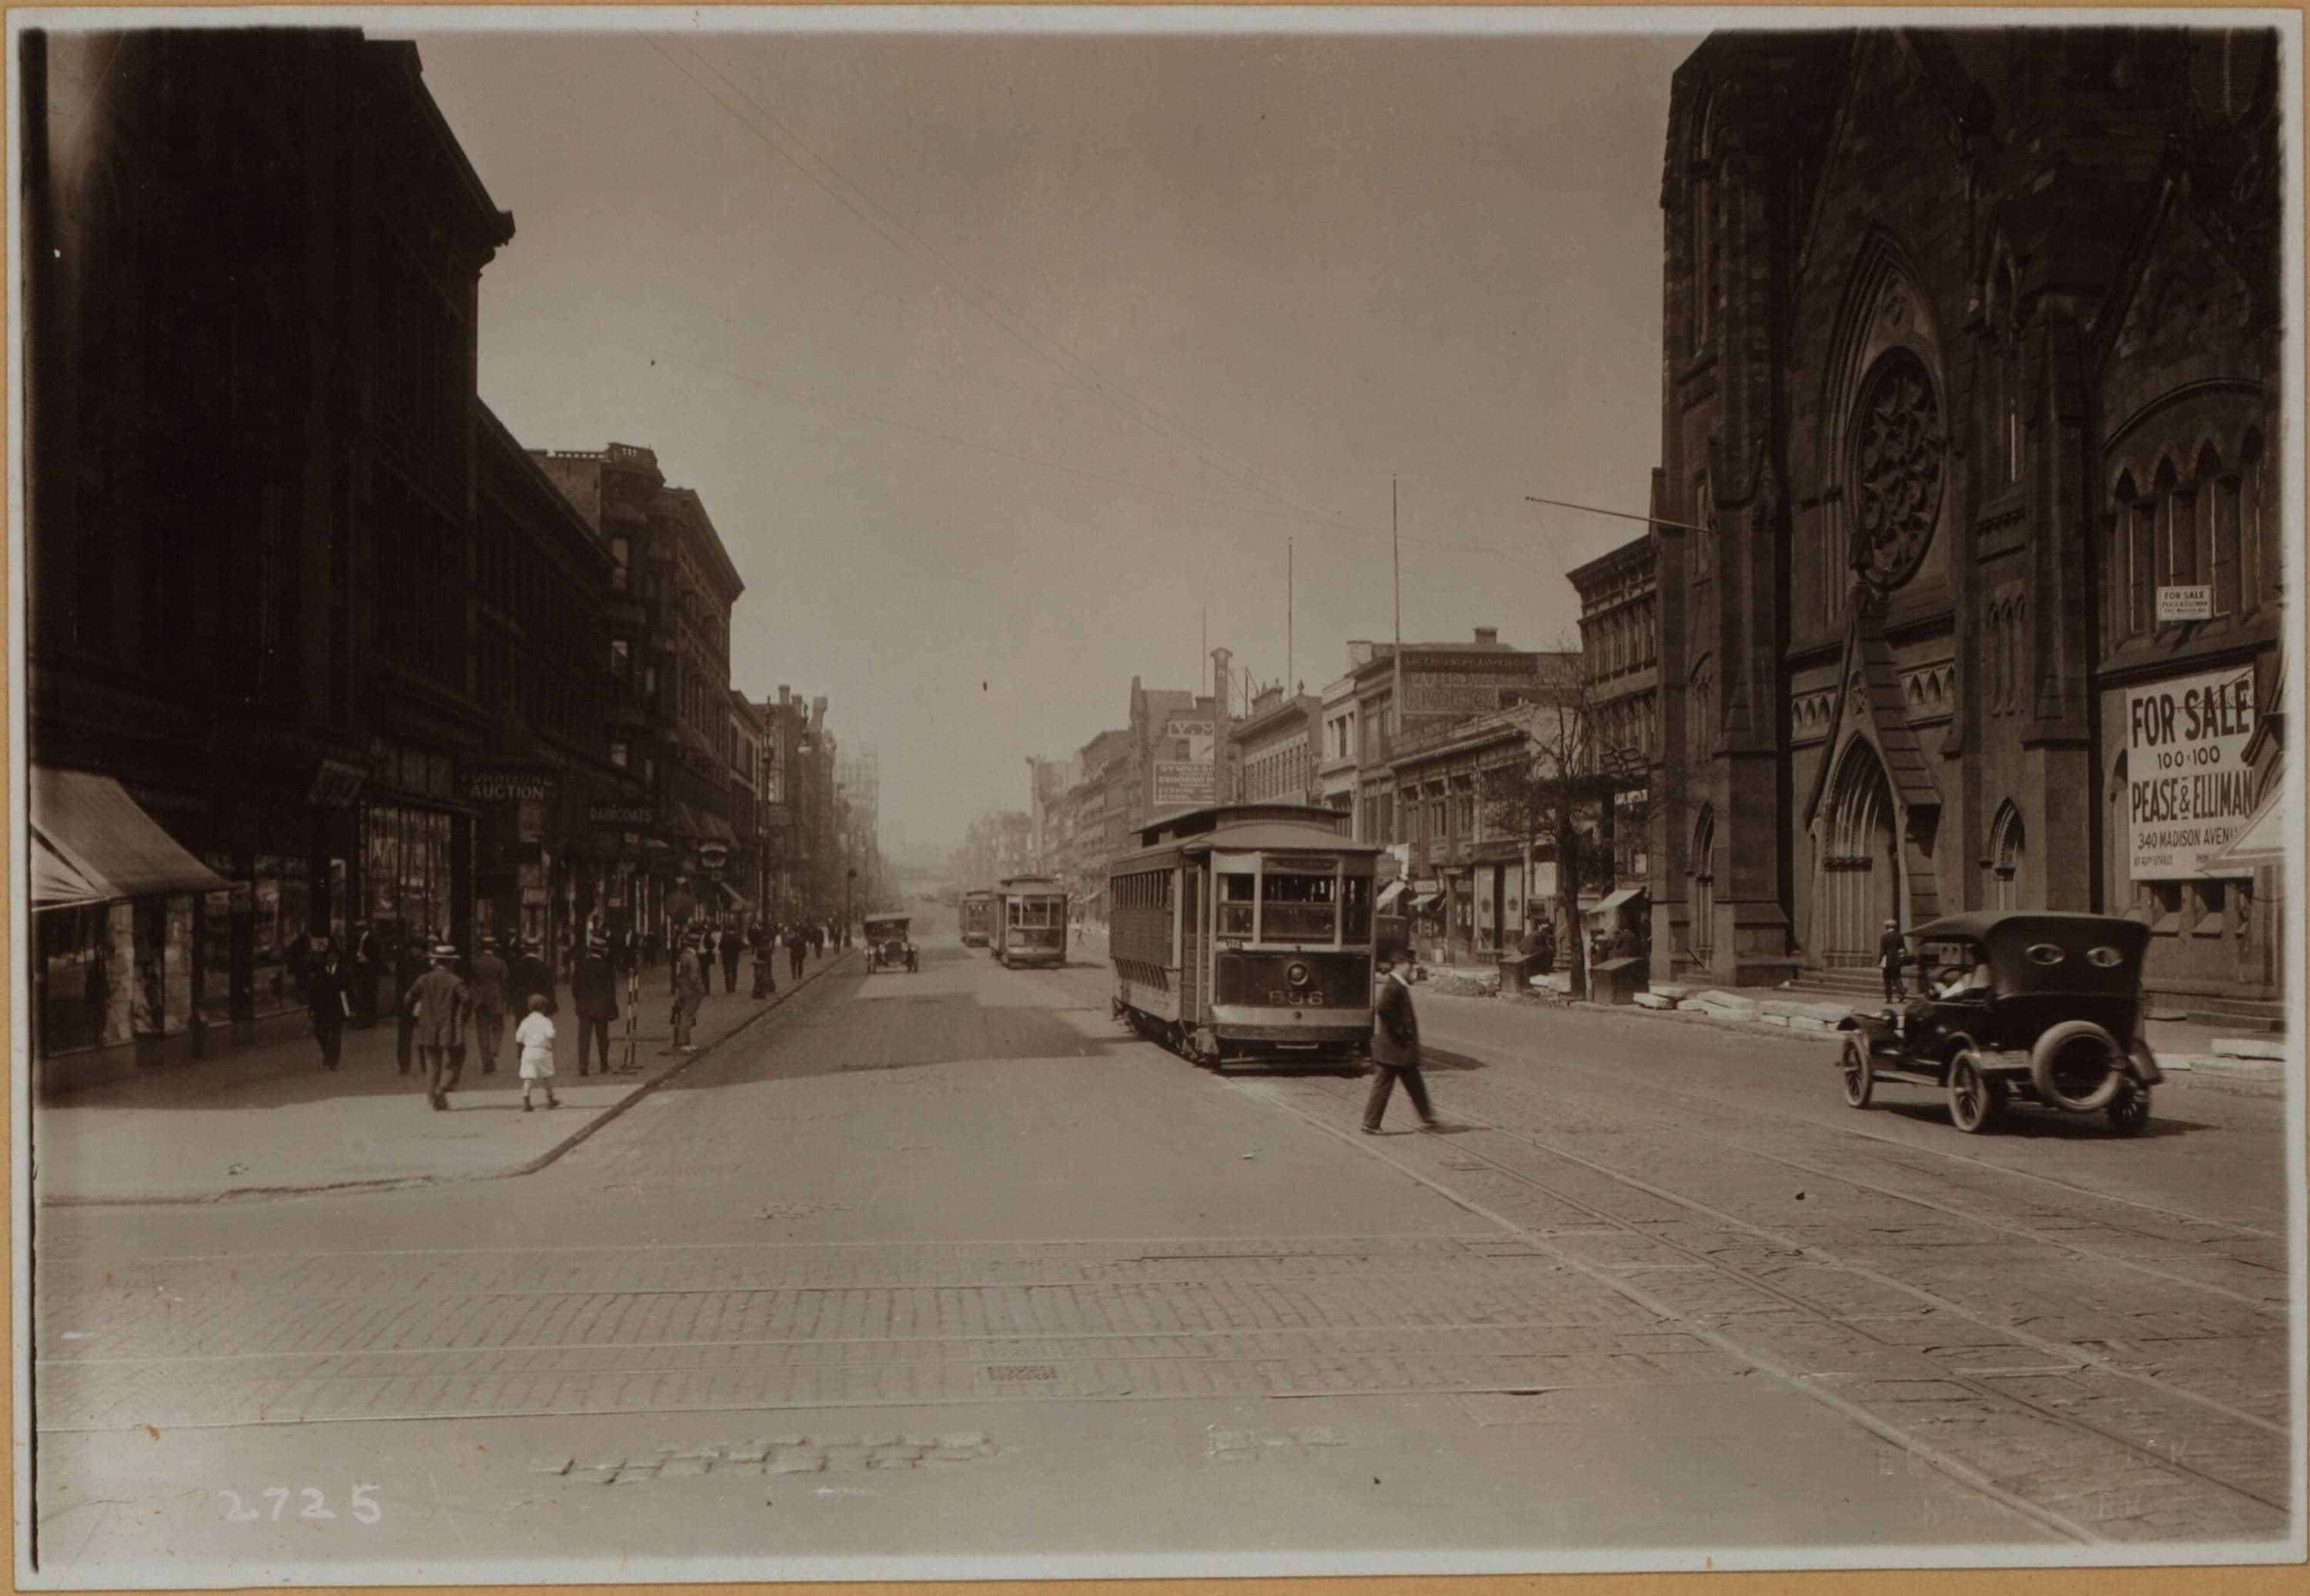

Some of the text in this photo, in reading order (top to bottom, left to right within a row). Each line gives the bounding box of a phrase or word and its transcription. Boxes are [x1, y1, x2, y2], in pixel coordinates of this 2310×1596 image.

[2165, 590, 2205, 599] FOR SALE
[2131, 679, 2251, 749] FOR SALE
[470, 784, 544, 800] AUCTION
[2131, 770, 2254, 823] PEASE & ELLIMAN
[590, 806, 654, 823] RAINCOATS
[2138, 832, 2158, 850] 340
[2159, 828, 2201, 848] MADISON
